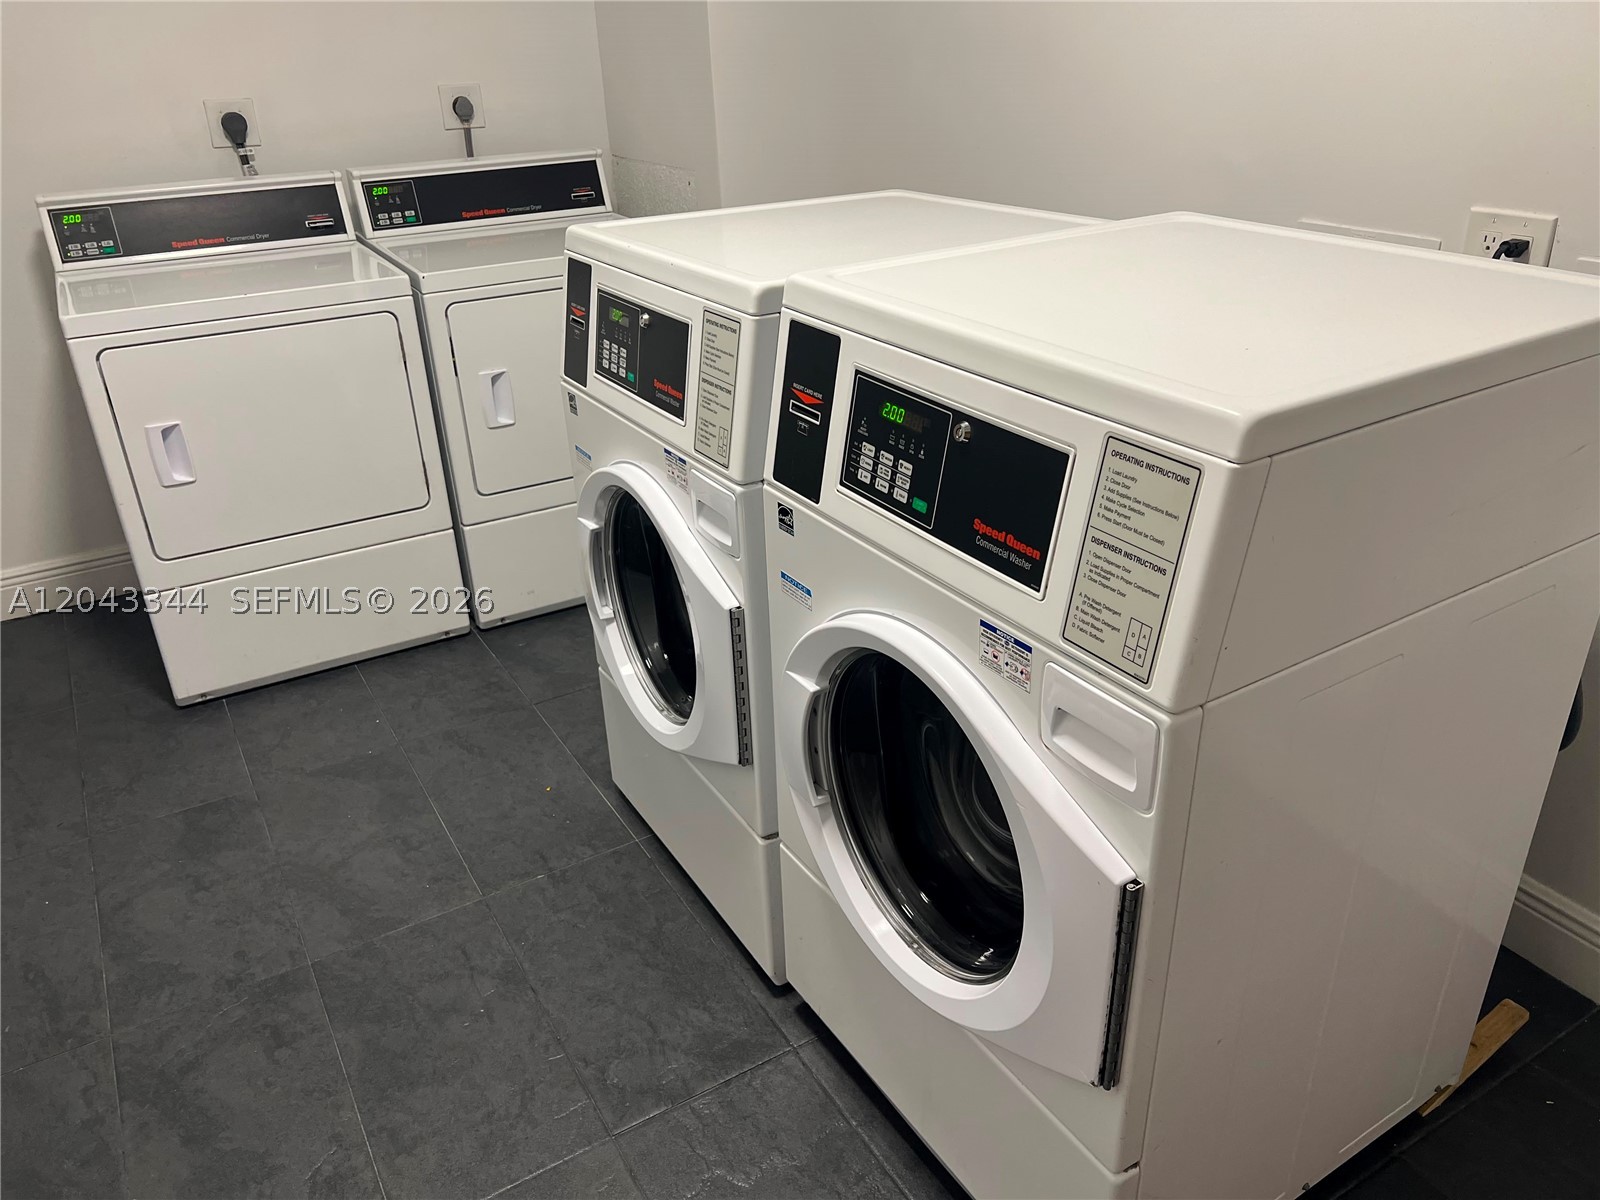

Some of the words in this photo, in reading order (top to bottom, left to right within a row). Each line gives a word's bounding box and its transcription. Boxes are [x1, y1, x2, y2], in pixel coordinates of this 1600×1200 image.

[372, 186, 388, 195] 2.00
[62, 214, 82, 224] 2.00
[462, 210, 484, 218] Speed
[506, 205, 531, 213] Commercial
[171, 239, 198, 248] Speed
[199, 237, 225, 245] Queen
[226, 234, 255, 243] Commercial
[793, 382, 804, 391] INSERT
[804, 387, 813, 396] CARD
[813, 391, 823, 400] HERE
[882, 402, 905, 423] 2.00
[1111, 449, 1144, 468] OPERATING
[1145, 462, 1190, 486] INSTRUCTIONS
[1111, 467, 1122, 477] Load
[1122, 471, 1138, 484] Laundry
[1110, 477, 1121, 487] Close
[1121, 482, 1131, 490] Door
[1103, 504, 1114, 514] Make
[1114, 509, 1131, 521] Payment
[1105, 496, 1116, 505] Make
[1117, 500, 1127, 510] Cycle
[1127, 505, 1145, 517] Selection
[1107, 486, 1116, 495] Add
[1116, 490, 1132, 502] Supplies
[1132, 496, 1142, 505] (See
[1142, 500, 1165, 515] Instructions
[1165, 510, 1180, 522] Below)
[1101, 513, 1113, 523] Press
[1113, 518, 1122, 527] Start
[1121, 521, 1133, 531] (Door
[1133, 527, 1143, 536] Must
[973, 518, 1006, 543] Speed
[1006, 534, 1041, 560] Queen
[975, 535, 1009, 559] Commercial
[1009, 552, 1032, 570] Washer
[1090, 535, 1122, 556] DISPENSER
[1123, 551, 1167, 576] INSTRUCTIONS
[1092, 552, 1103, 562] Open
[1103, 556, 1121, 570] Dispenser
[1121, 565, 1132, 574] Door
[784, 575, 809, 594] NOTICE
[1087, 574, 1098, 584] Close
[1098, 579, 1116, 593] Dispenser
[1116, 589, 1127, 598] Door
[1090, 561, 1100, 571] Load
[1100, 565, 1116, 578] Supplies
[1120, 575, 1133, 587] Proper
[1133, 582, 1160, 599] Compartment
[1093, 570, 1111, 582] Indicated
[1083, 593, 1091, 601] Pre
[1091, 597, 1102, 607] Wash
[1102, 603, 1122, 617] Detergent
[1078, 616, 1090, 627] Liquid
[1090, 622, 1103, 633] Bleach
[1080, 607, 1090, 616] Main
[1090, 613, 1101, 623] Wash
[1101, 619, 1121, 633] Detergent
[996, 629, 1015, 644] NOTICE
[1076, 624, 1088, 635] Fabric
[1088, 631, 1105, 644] Softener
